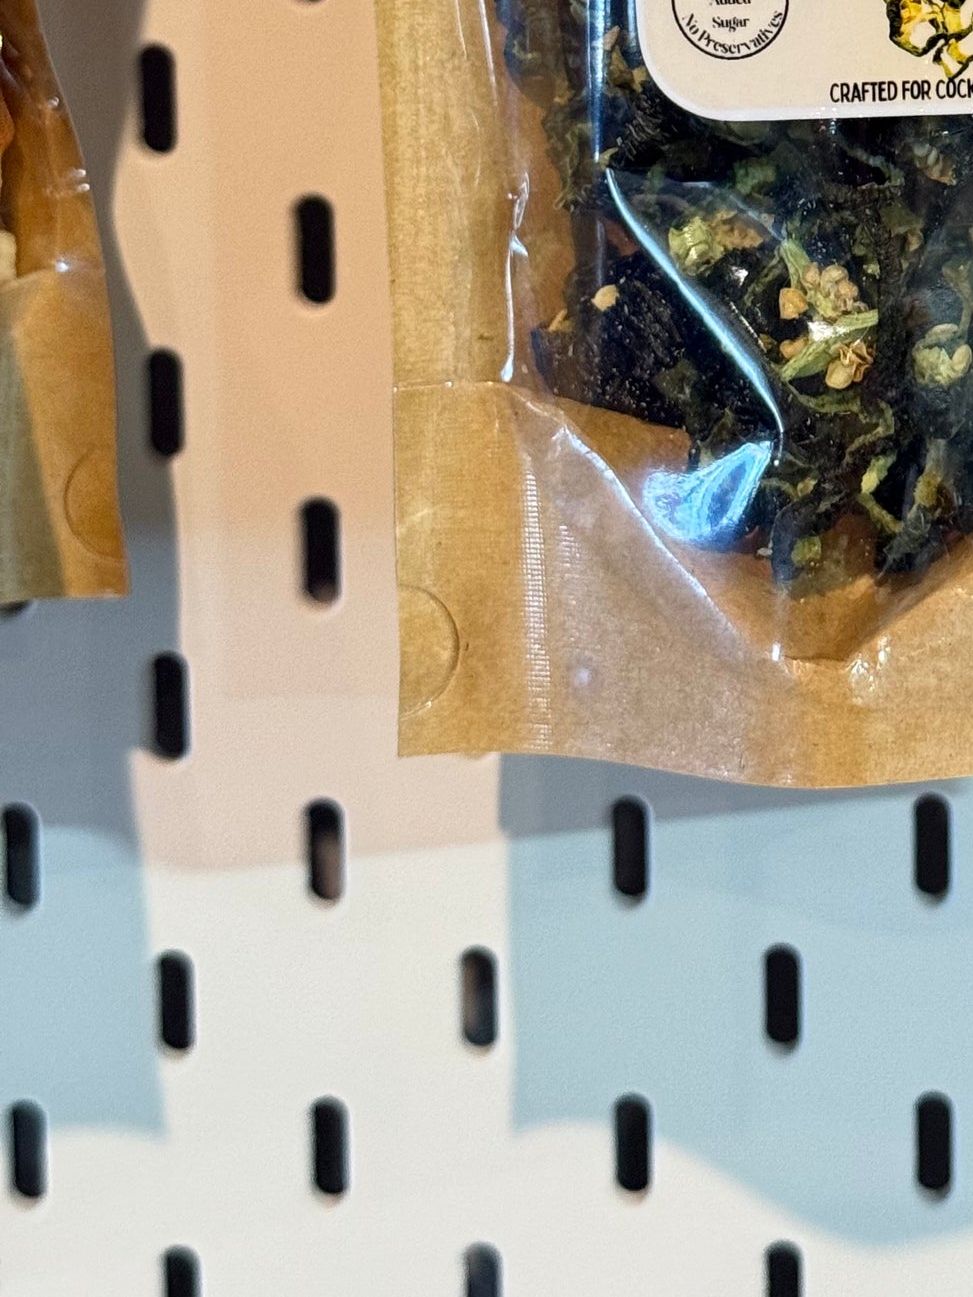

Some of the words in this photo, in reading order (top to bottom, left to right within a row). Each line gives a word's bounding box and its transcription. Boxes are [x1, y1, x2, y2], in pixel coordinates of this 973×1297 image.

[682, 12, 700, 35] No
[697, 10, 783, 54] Preservatives
[712, 15, 750, 33] Sugar
[829, 81, 898, 103] CRAFTED
[901, 79, 932, 101] FOR
